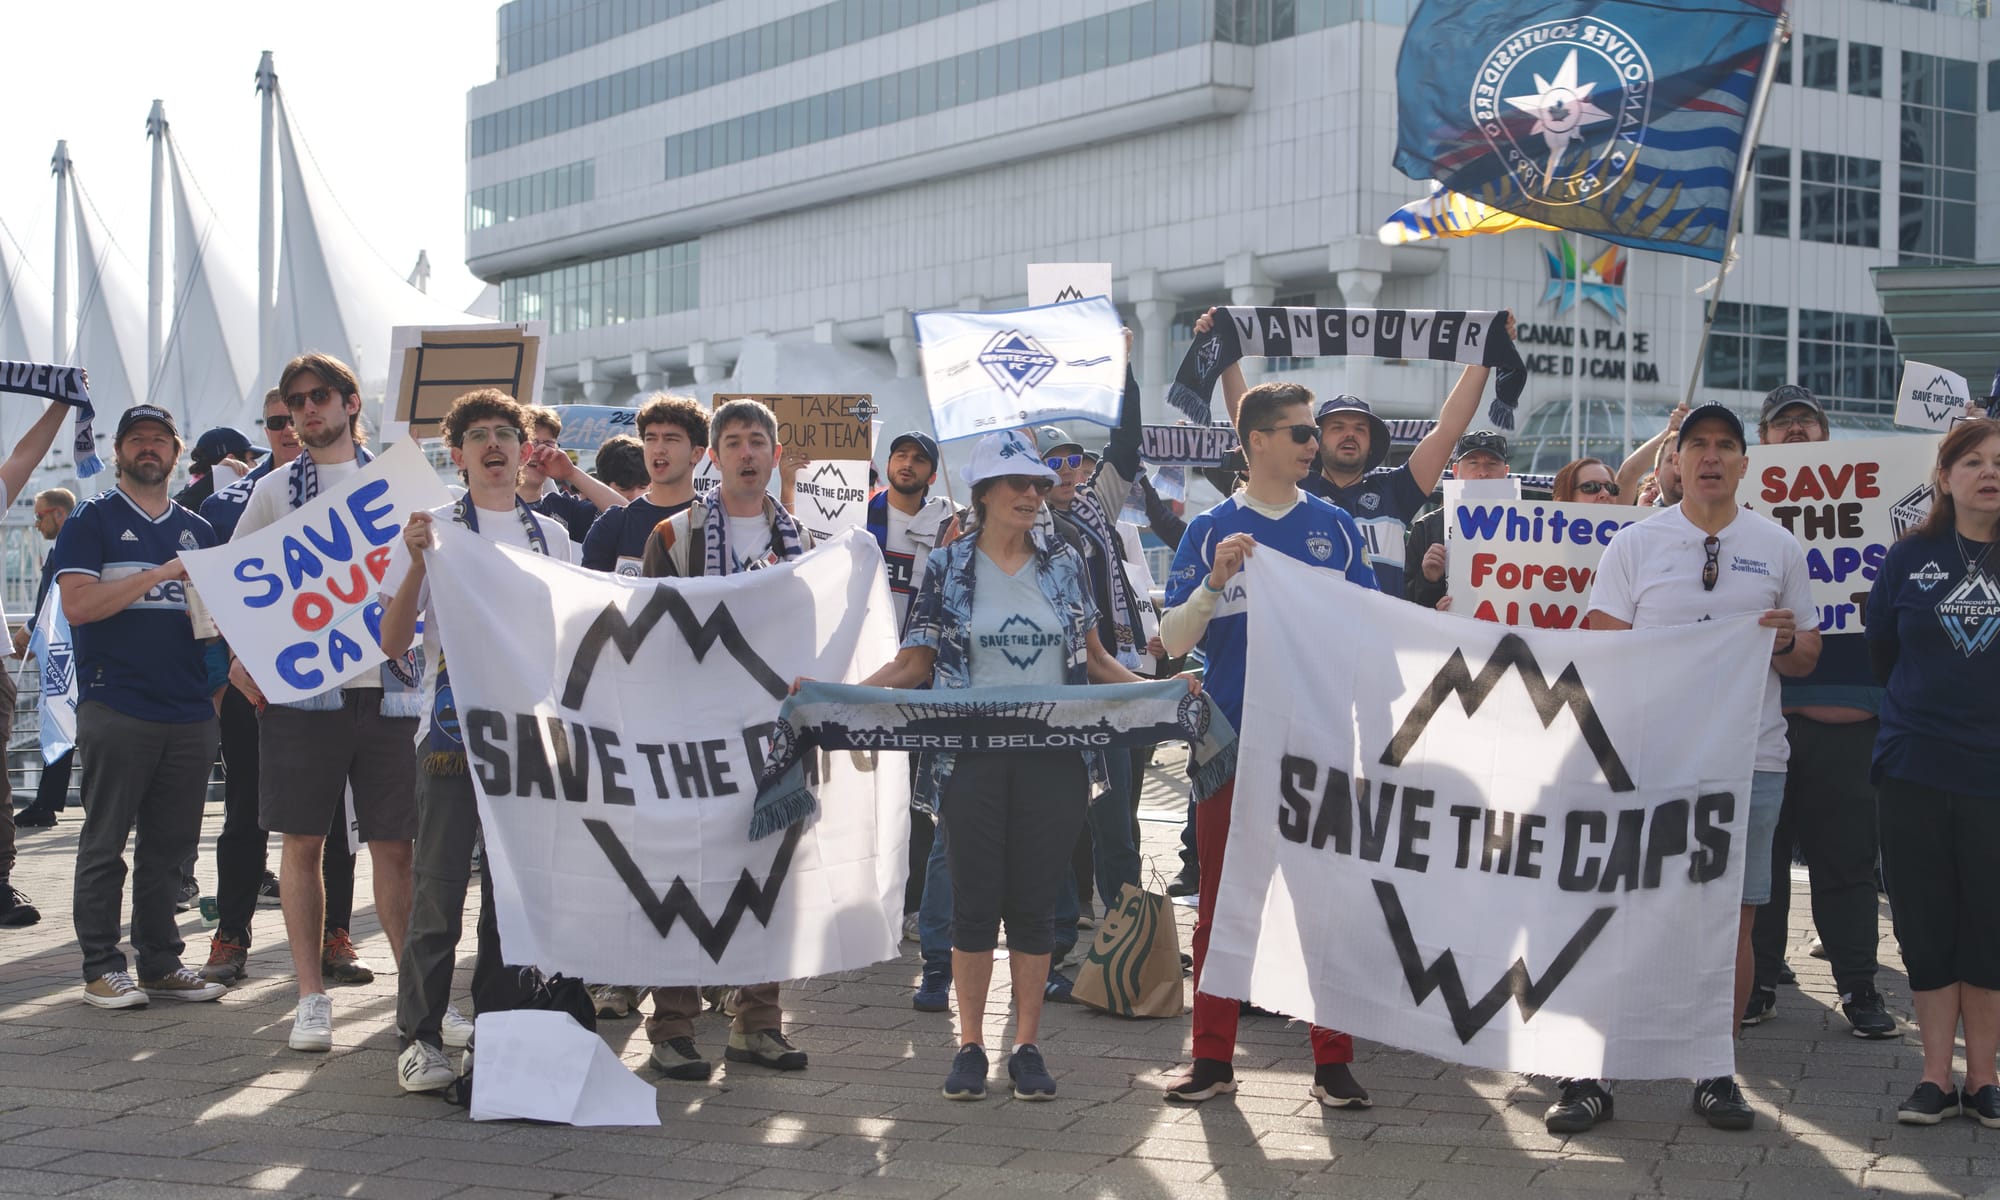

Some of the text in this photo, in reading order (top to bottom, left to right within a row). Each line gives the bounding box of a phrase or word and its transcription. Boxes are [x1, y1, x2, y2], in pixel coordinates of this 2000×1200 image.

[1234, 315, 1482, 347] VANCOUVER
[1517, 324, 1589, 348] CANADA
[980, 354, 1054, 366] WHITECAPS
[1009, 363, 1025, 371] FC
[1526, 354, 1558, 375] ACE
[1912, 390, 1964, 408] SAVE THE CAPS
[820, 422, 869, 448] TEAM
[797, 482, 864, 502] SAVE THE CAPS
[1761, 462, 1880, 503] SAVE
[1457, 505, 1632, 547] Whitec
[1772, 502, 1864, 541] THE
[234, 479, 400, 608] SAVE
[1471, 552, 1597, 593] Forev
[1807, 544, 1888, 583] APS
[292, 546, 392, 632] OUR
[1816, 603, 1856, 631] ur
[1964, 616, 1979, 625] FC
[275, 601, 384, 690] CAP
[980, 633, 1061, 648] SAVE THE CAPS
[845, 732, 1111, 749] WHERE I BELONG
[466, 709, 636, 807] SAVE
[637, 739, 739, 799] THE
[1278, 754, 1735, 893] SAVE THE CAPS
